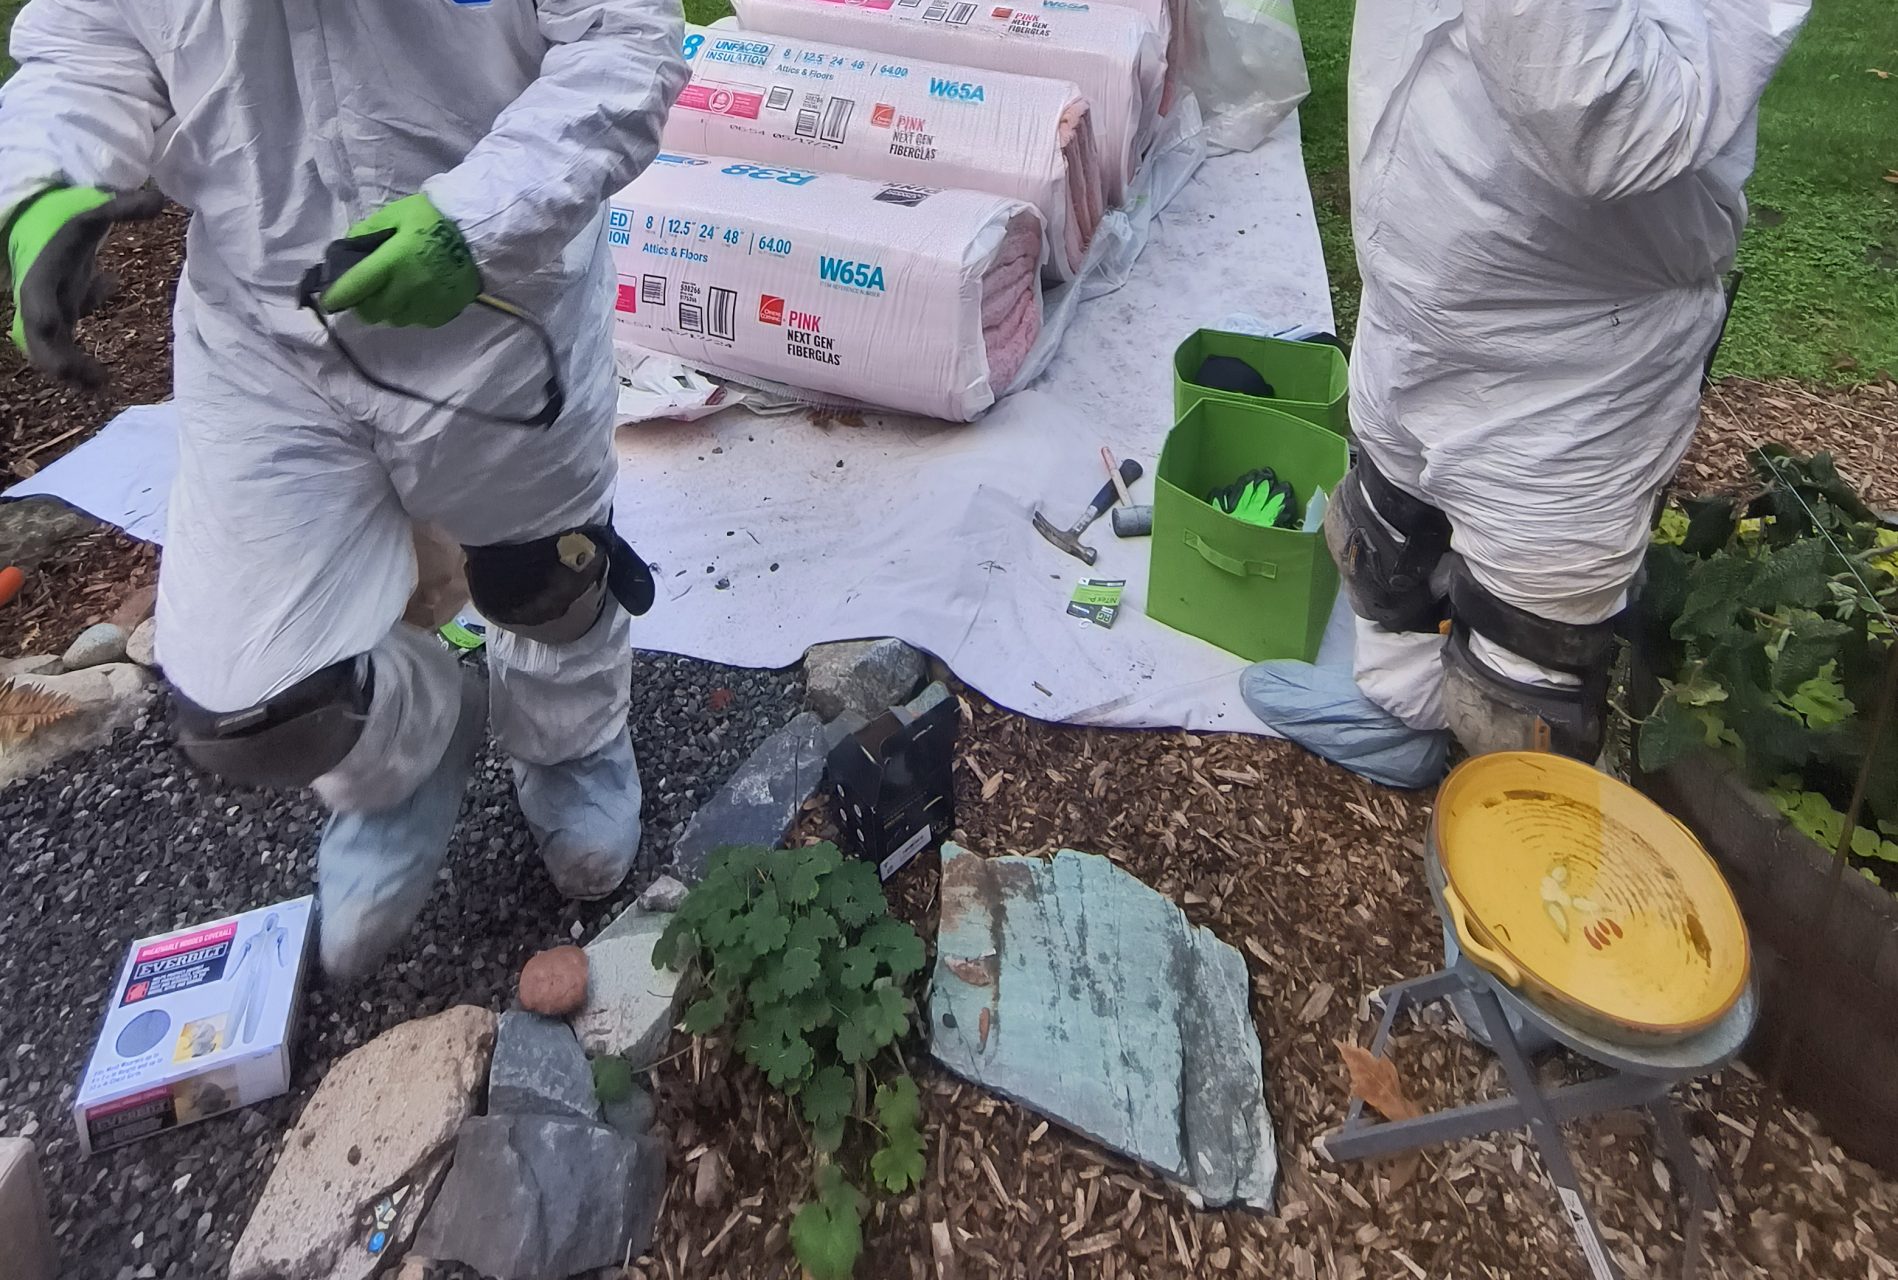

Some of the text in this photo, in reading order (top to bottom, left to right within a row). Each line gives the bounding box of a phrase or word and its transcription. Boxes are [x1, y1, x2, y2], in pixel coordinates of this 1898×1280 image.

[1011, 19, 1031, 28] NEXT
[1014, 12, 1040, 22] PINK
[1008, 25, 1051, 37] FIBERGLAS
[715, 40, 769, 54] UNFACED
[705, 51, 768, 66] INSULATION
[776, 64, 834, 81] Attics & Floors
[929, 77, 985, 102] W65A
[897, 115, 926, 132] PINK
[893, 131, 934, 146] NEXT GEN
[889, 144, 937, 161] FIBERGLAS
[721, 164, 818, 186] R38
[645, 215, 654, 229] 8
[758, 235, 792, 255] 64.00
[642, 242, 709, 263] Attics & Floors
[819, 255, 886, 291] W65A
[789, 310, 821, 333] PINK
[787, 329, 834, 350] NEXT GEN
[787, 343, 841, 366] FIBERGLAS
[204, 927, 232, 942] COVERALL
[140, 944, 225, 975] EVERBILT
